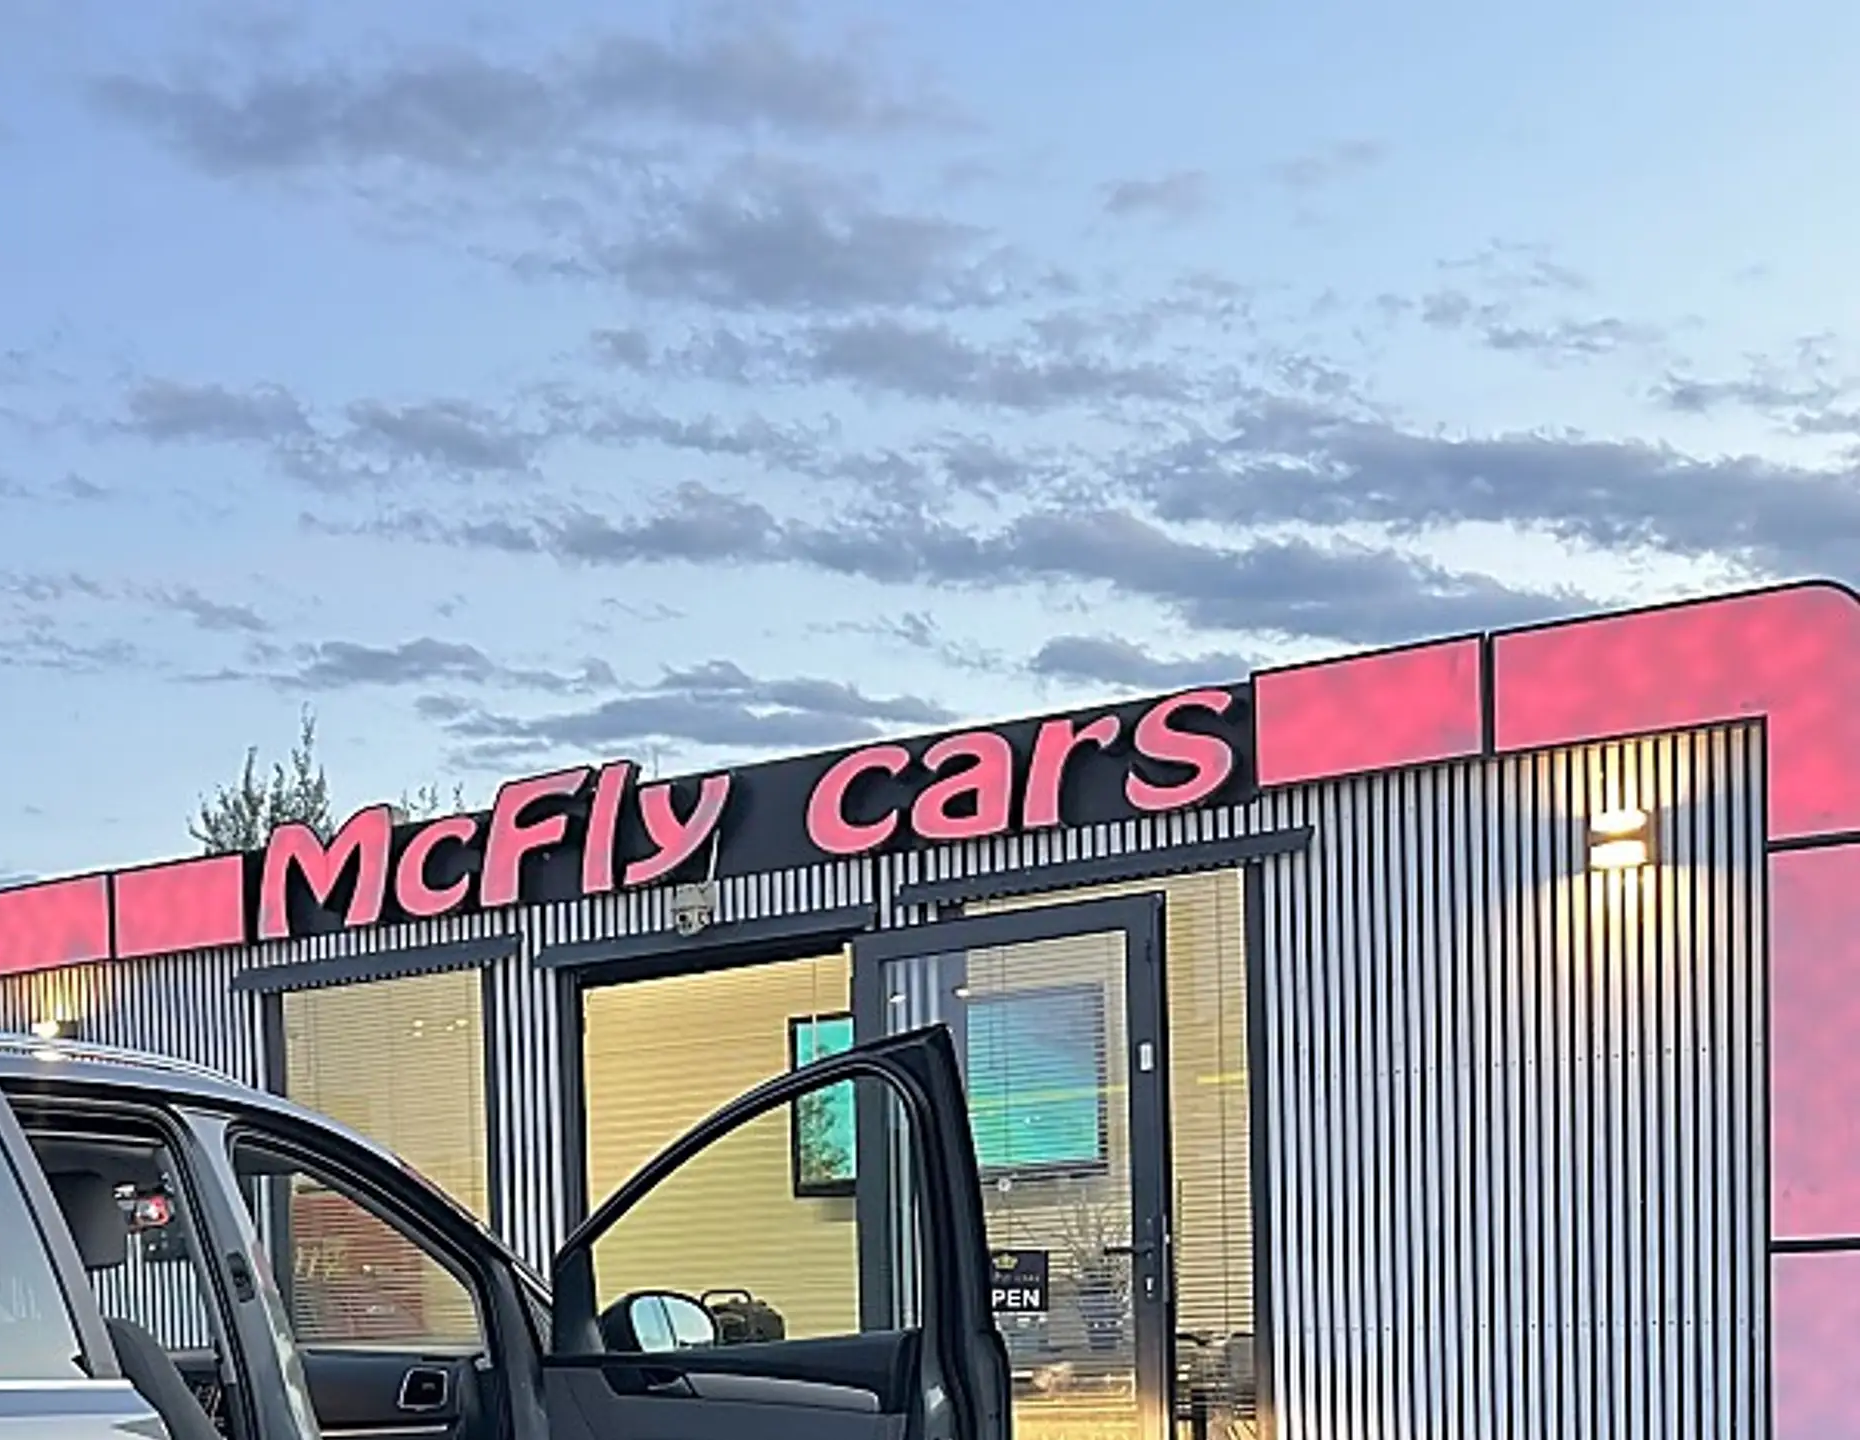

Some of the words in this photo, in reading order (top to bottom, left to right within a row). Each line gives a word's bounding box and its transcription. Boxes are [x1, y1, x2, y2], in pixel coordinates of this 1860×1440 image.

[259, 760, 730, 940] McFly
[806, 690, 1232, 854] cars
[991, 1288, 1040, 1309] PEN
